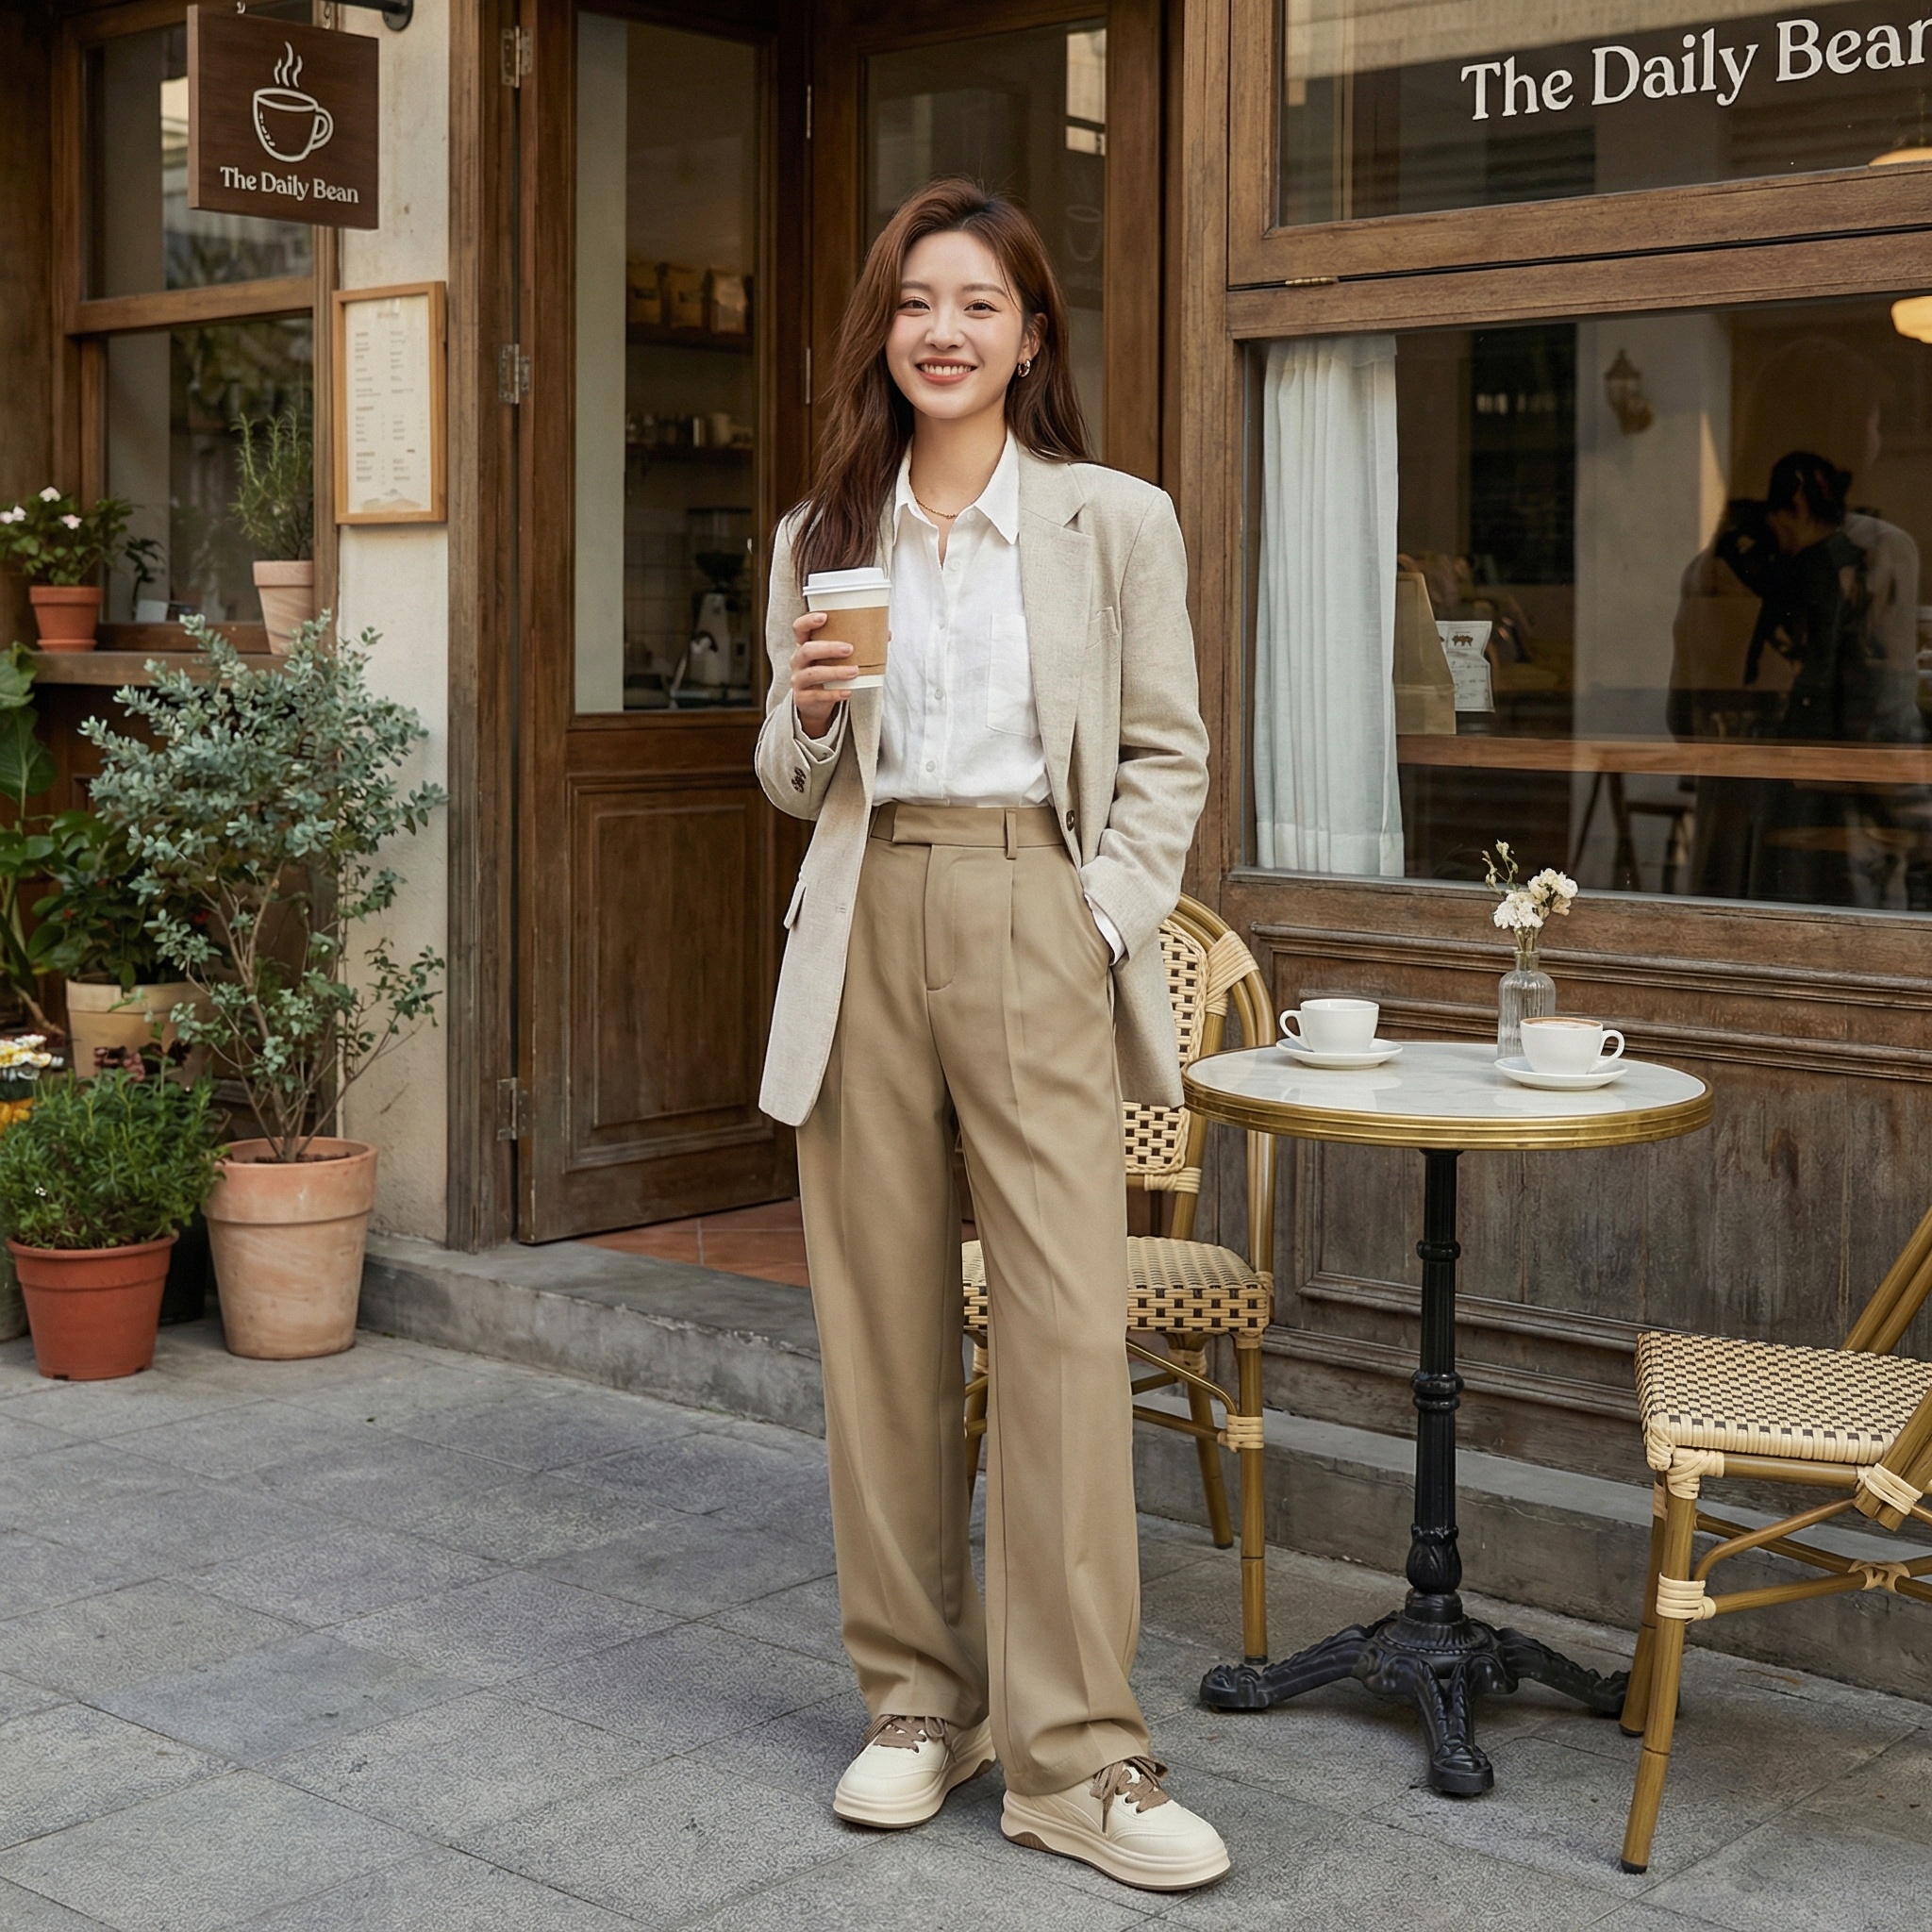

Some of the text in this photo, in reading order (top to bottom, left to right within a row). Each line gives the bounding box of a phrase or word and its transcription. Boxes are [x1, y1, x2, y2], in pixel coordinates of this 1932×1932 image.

[1461, 57, 1574, 120] The
[1592, 28, 1759, 107] Daily
[220, 166, 359, 204] The Daily Bean
